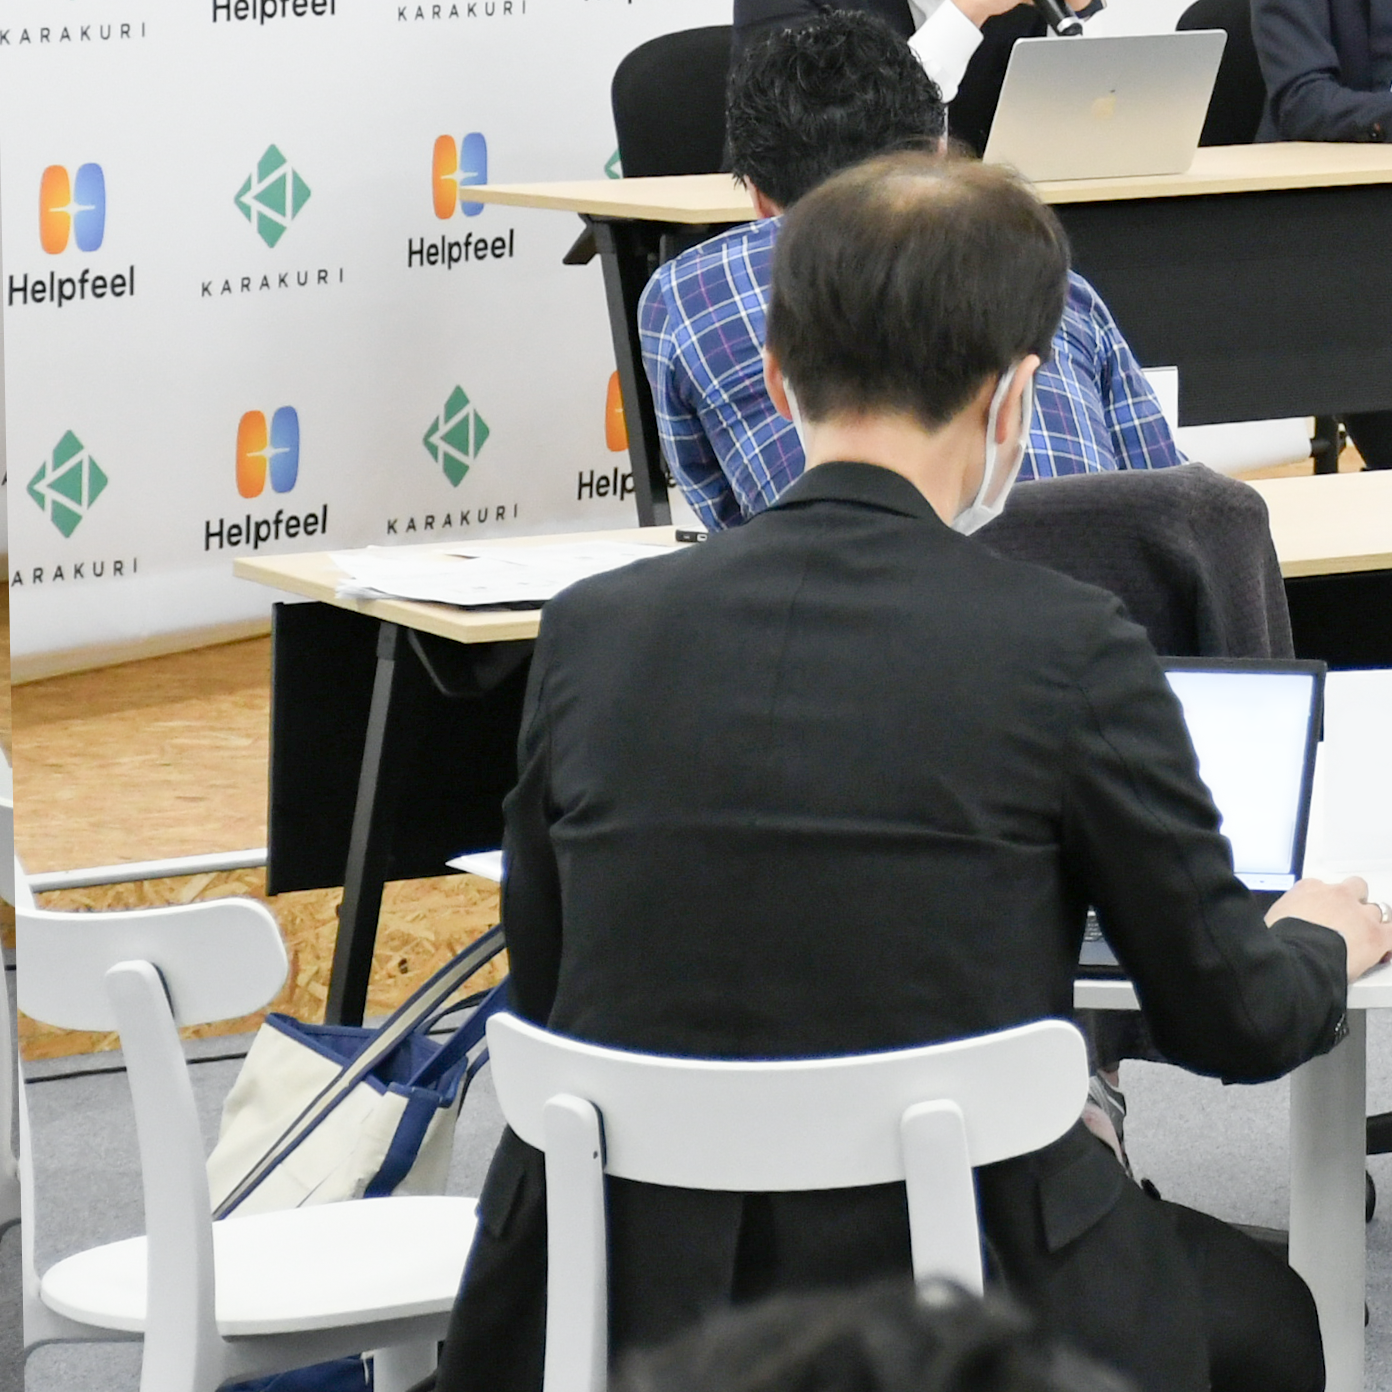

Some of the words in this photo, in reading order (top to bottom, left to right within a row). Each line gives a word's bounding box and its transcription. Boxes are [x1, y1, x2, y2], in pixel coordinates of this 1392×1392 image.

[398, 0, 526, 21] KARAKURI
[0, 22, 145, 45] KARAKURI
[407, 228, 515, 270] Helpfeel
[8, 265, 135, 308] Helpfeel
[201, 267, 343, 297] KARAKURI
[577, 466, 678, 502] Help
[204, 503, 328, 552] Helpfeel
[387, 504, 518, 534] KARAKURI
[11, 558, 137, 587] ARAKURI
